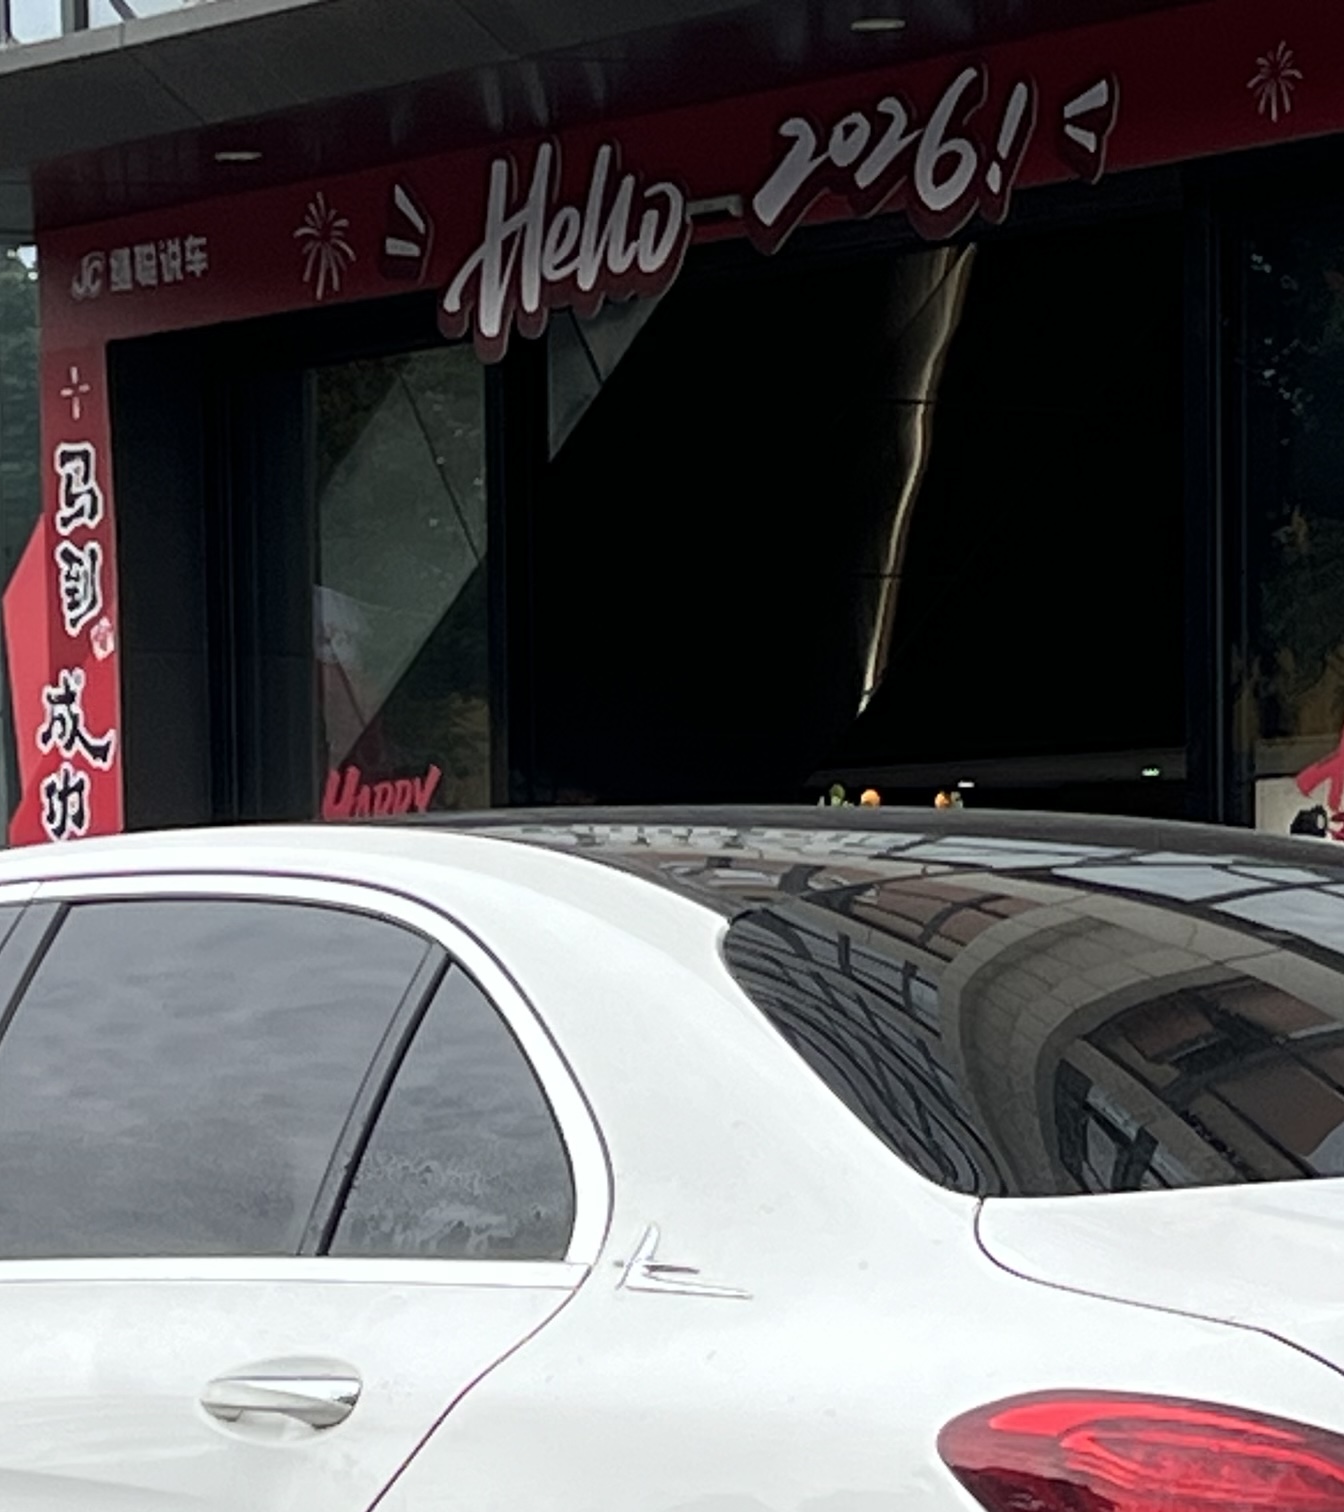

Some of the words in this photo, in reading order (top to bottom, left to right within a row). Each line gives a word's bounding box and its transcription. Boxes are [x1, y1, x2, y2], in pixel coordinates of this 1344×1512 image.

[442, 142, 685, 338] Hello
[754, 67, 1028, 226] 2026!
[38, 444, 115, 840] 马到成功
